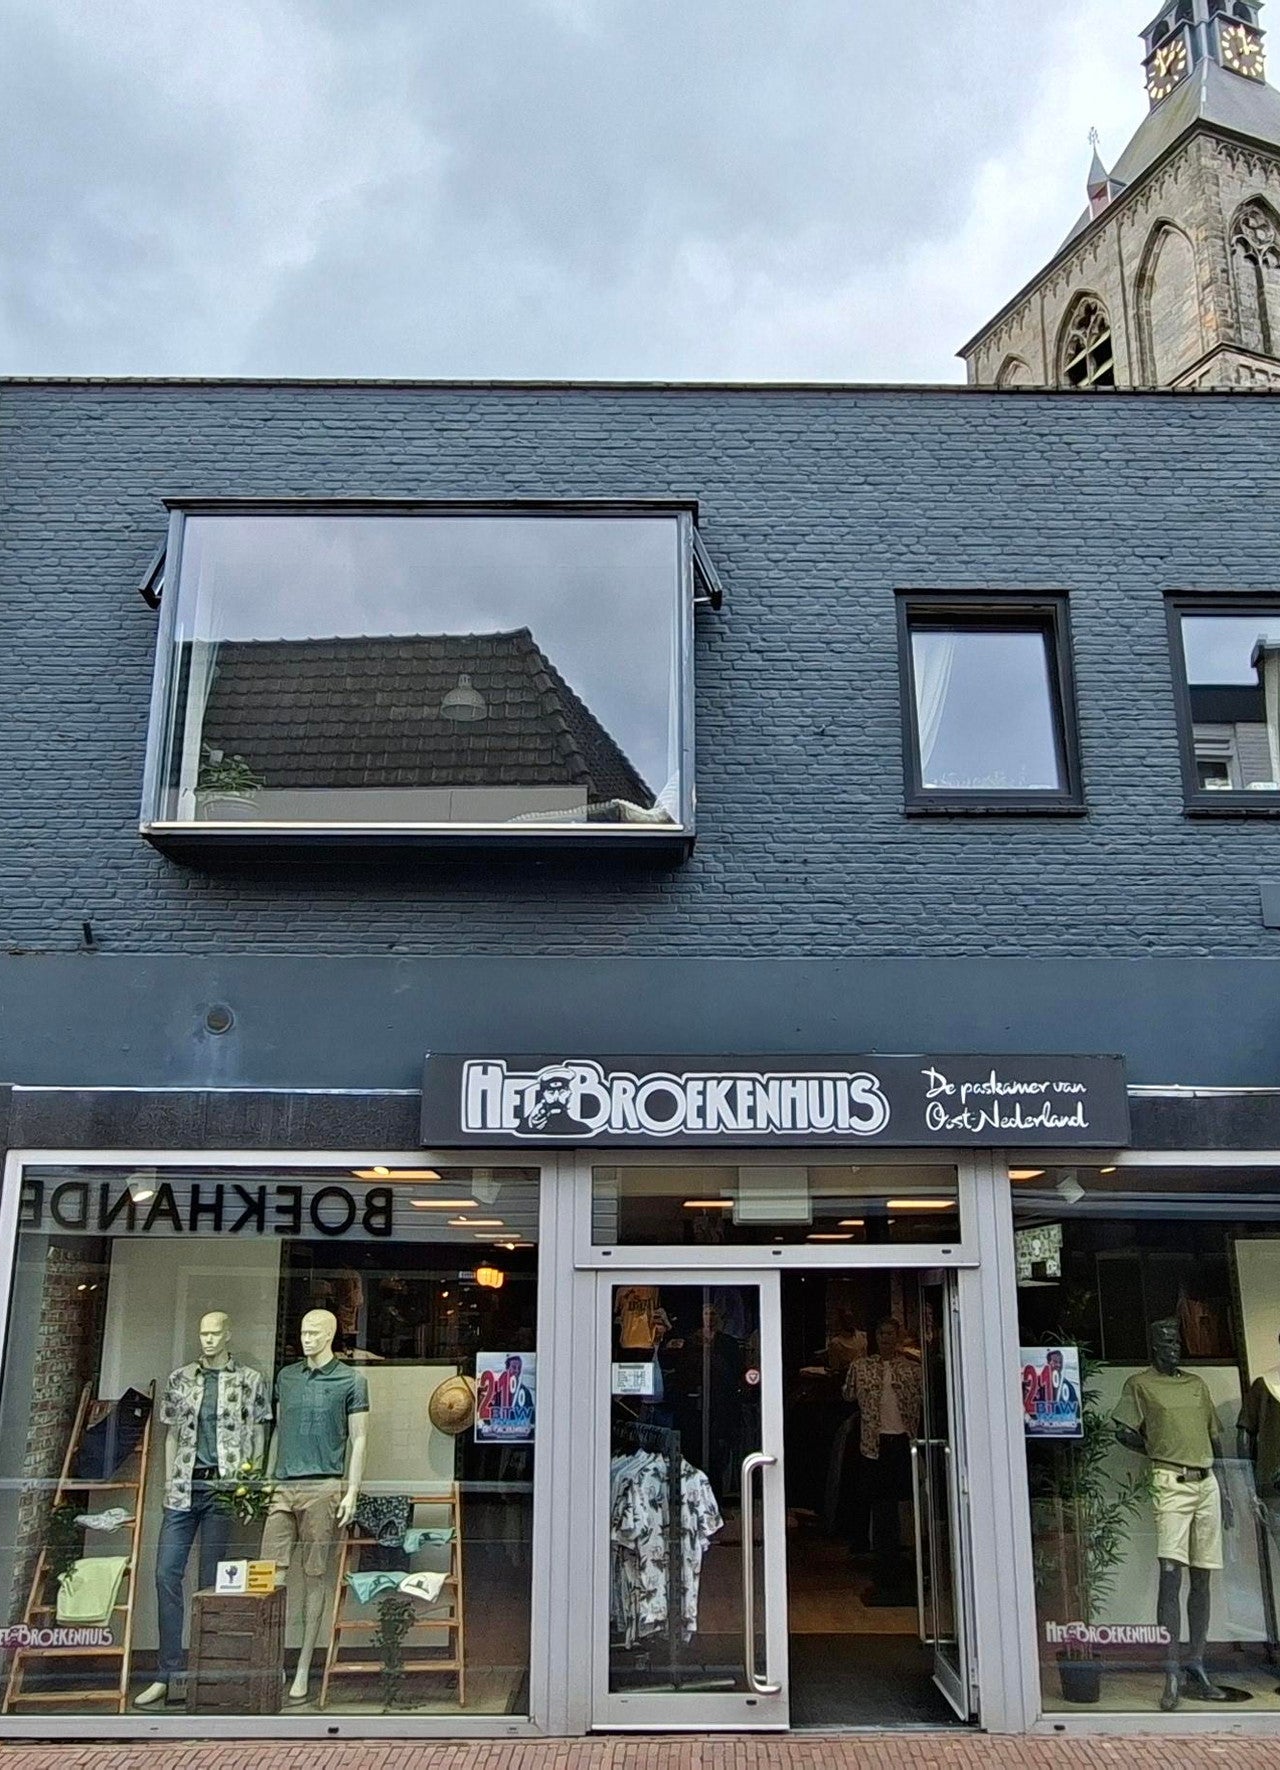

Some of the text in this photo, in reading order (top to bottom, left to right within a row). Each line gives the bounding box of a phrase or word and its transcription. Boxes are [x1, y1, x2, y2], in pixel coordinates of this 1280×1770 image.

[467, 1063, 885, 1133] HET BROEKENHUIS
[921, 1066, 1087, 1105] De paskamer van
[478, 1370, 526, 1420] 21%
[1022, 1364, 1070, 1415] 21%
[18, 1623, 113, 1647] BROEKENHUIS
[1075, 1620, 1171, 1645] BROEKENHUIS
